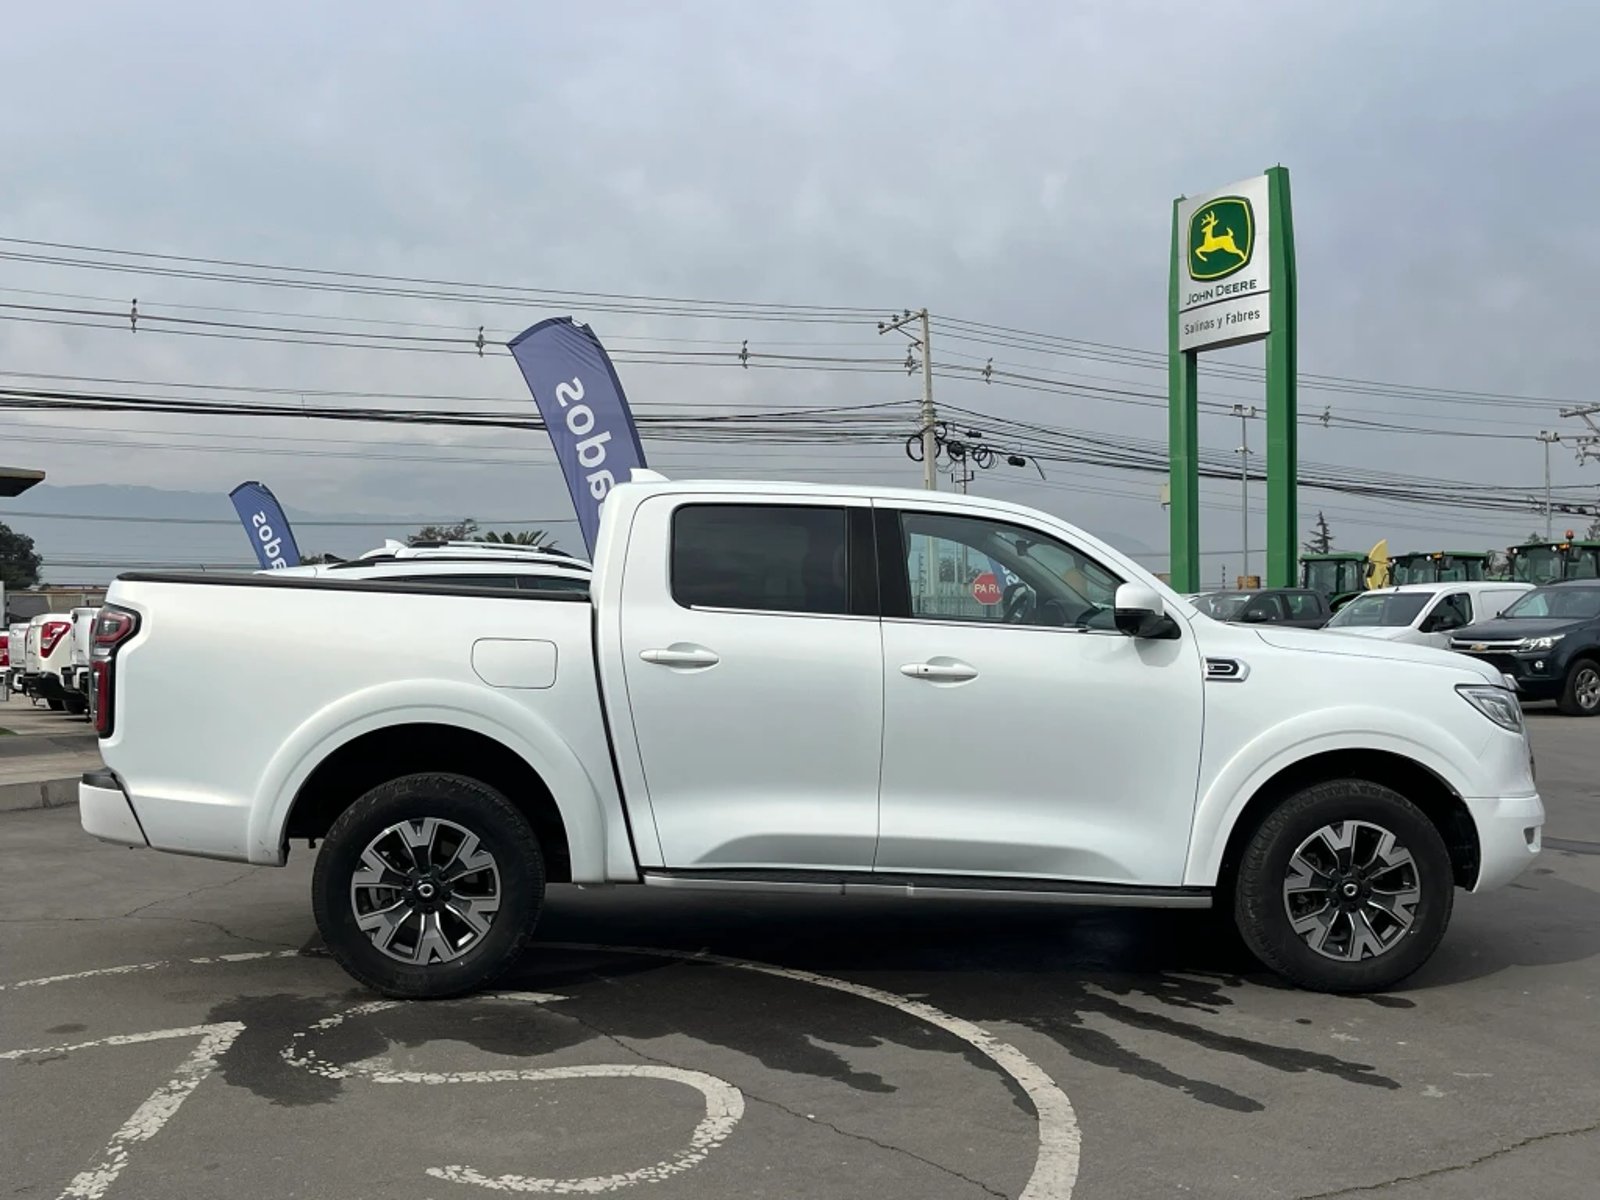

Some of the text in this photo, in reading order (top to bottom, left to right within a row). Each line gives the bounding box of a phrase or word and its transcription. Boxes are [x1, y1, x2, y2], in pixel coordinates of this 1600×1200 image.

[1186, 280, 1256, 305] JOHN DEERE
[1185, 310, 1260, 335] Salinas y Fabres
